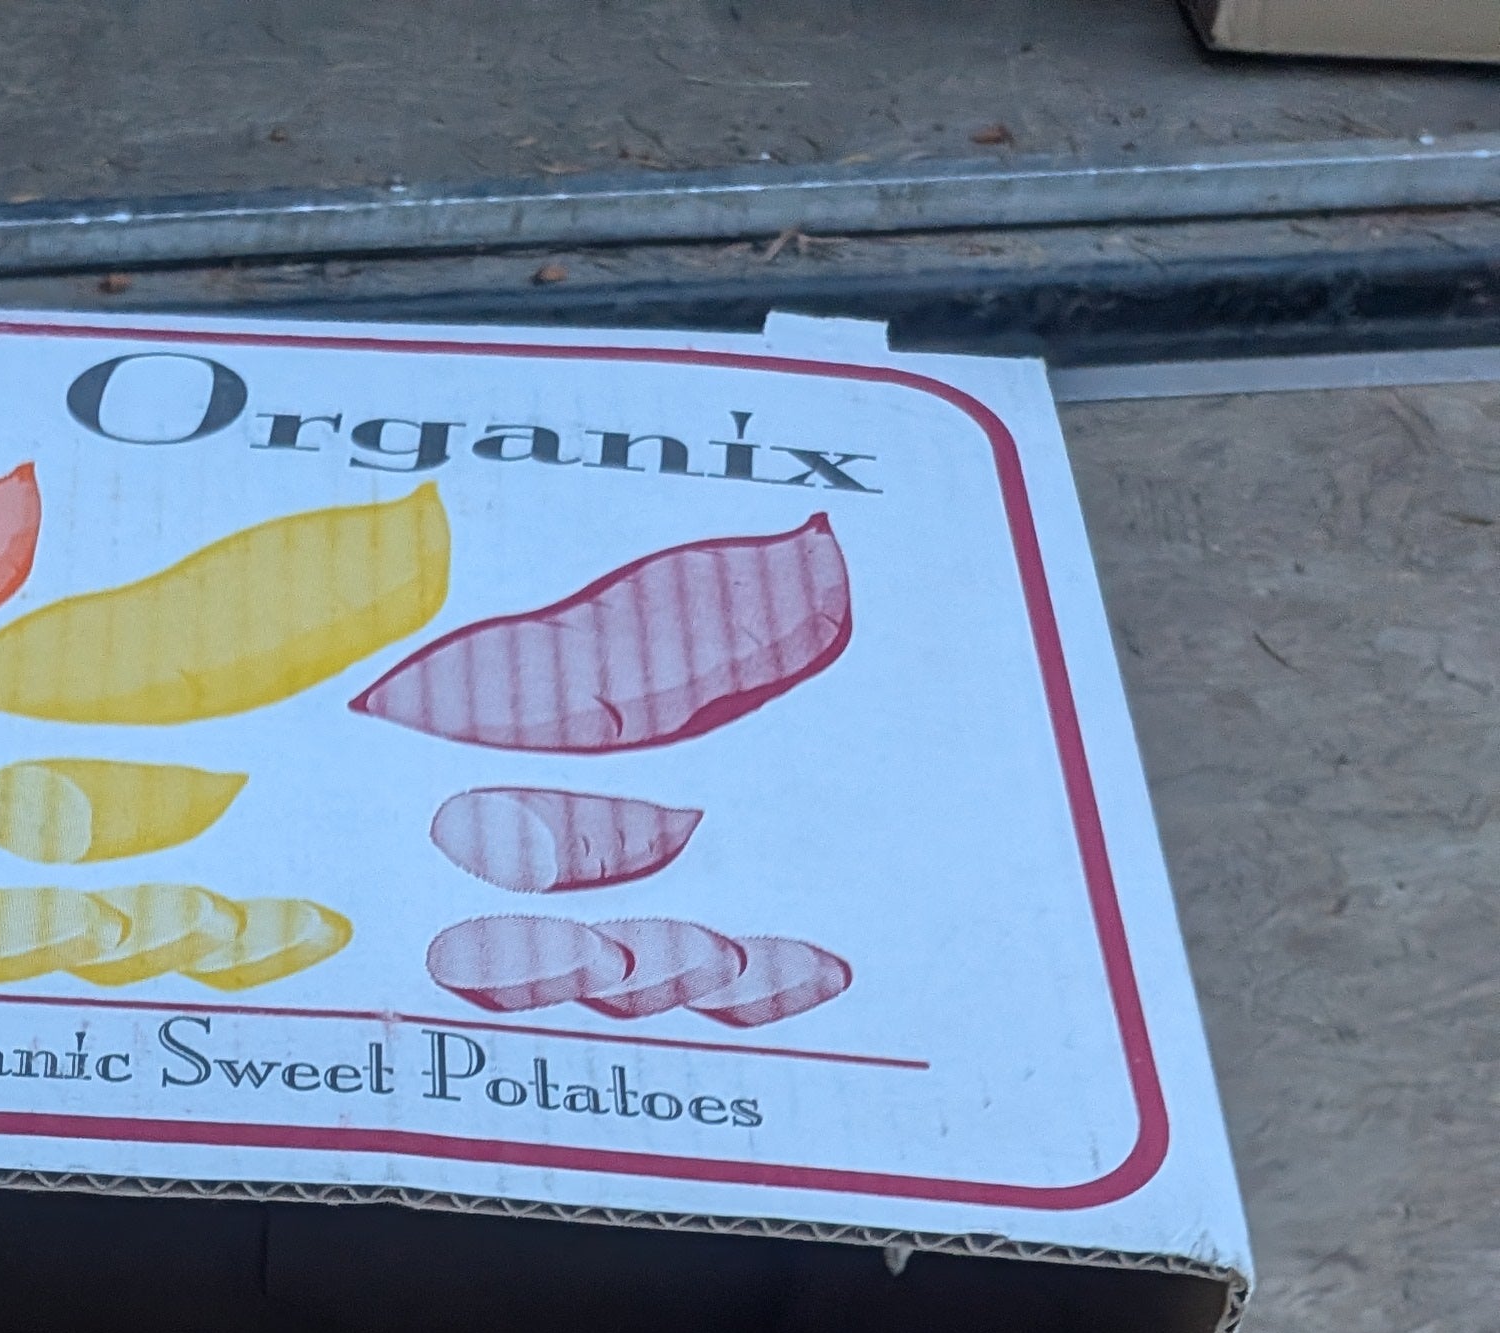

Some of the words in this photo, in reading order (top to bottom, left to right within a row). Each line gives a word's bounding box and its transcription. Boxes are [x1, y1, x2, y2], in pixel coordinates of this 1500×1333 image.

[64, 351, 884, 494] Organix
[158, 1015, 395, 1094] Sweet
[420, 1029, 764, 1128] Potatoes
